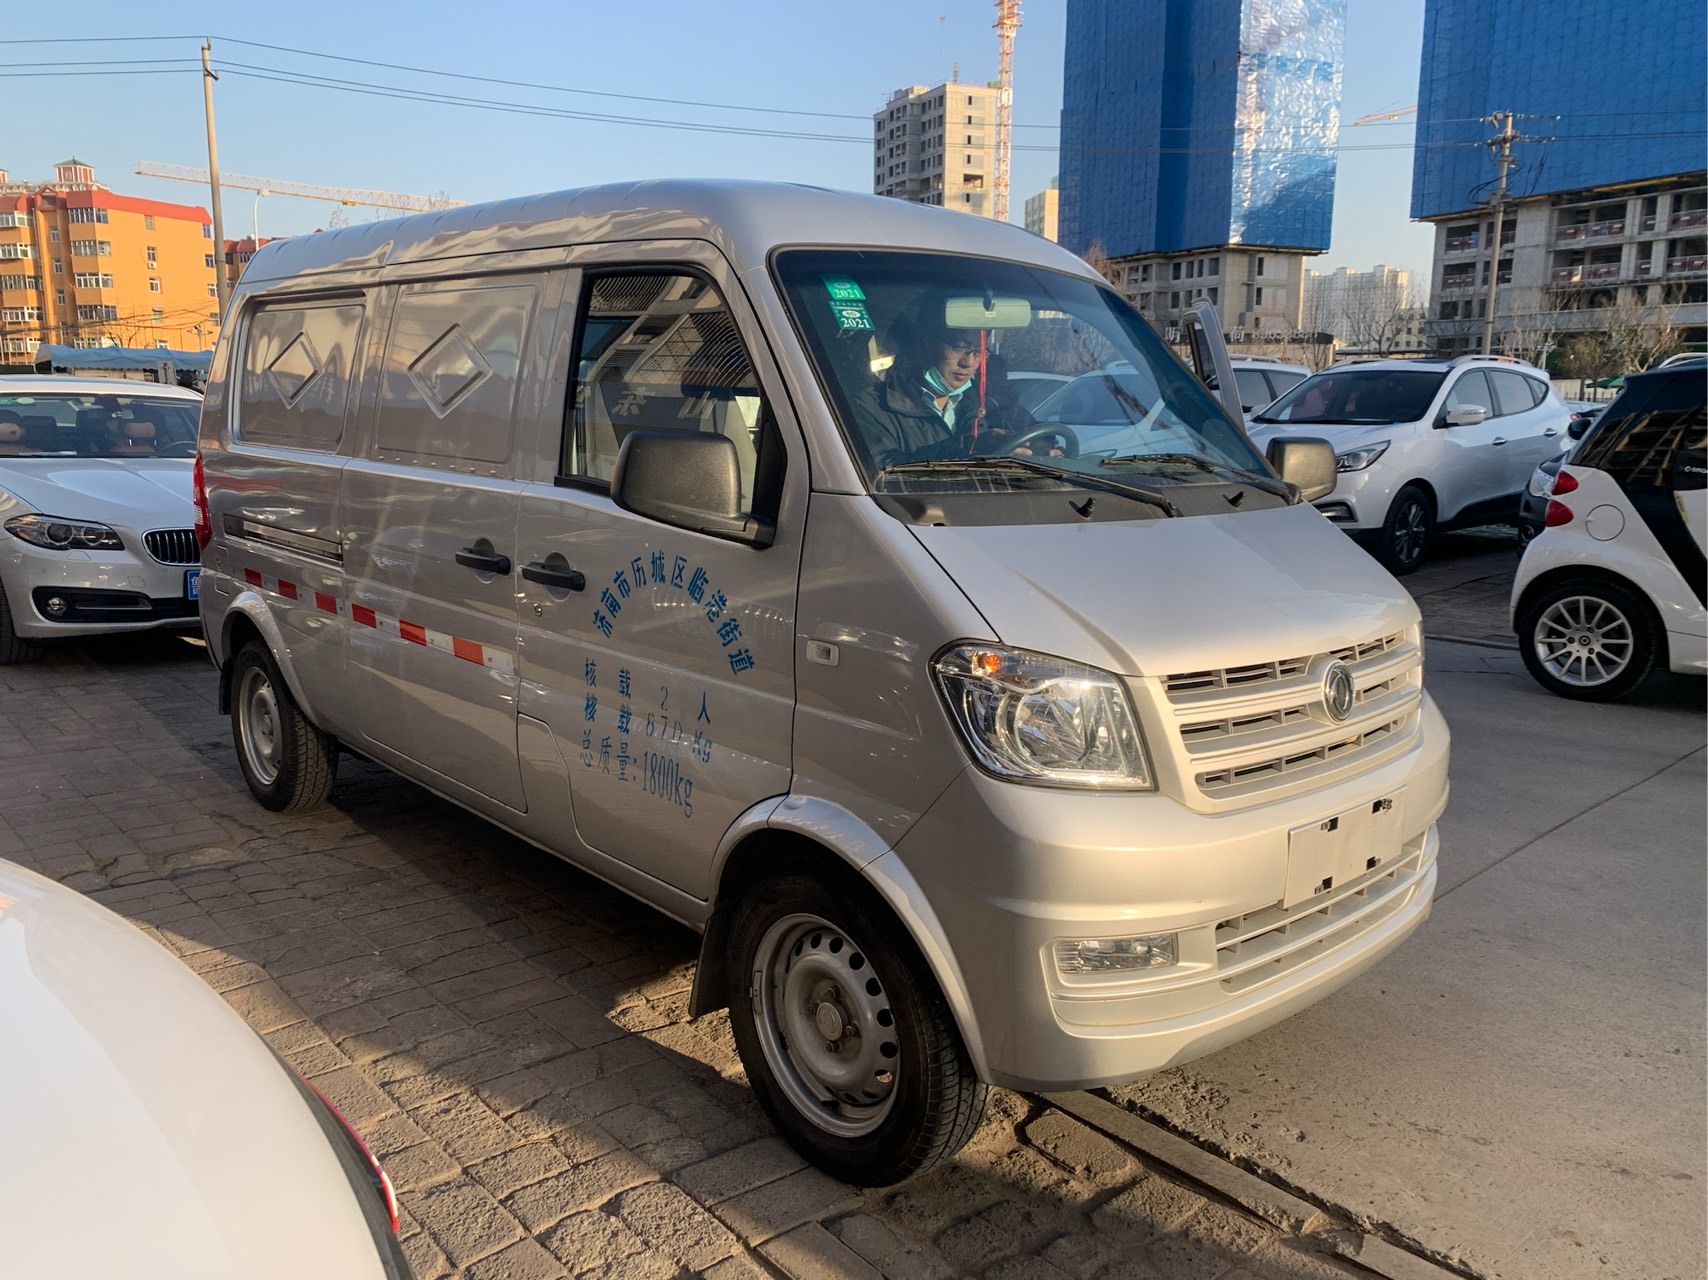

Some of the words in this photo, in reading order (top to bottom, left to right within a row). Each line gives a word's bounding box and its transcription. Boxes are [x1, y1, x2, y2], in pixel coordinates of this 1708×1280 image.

[834, 289, 861, 298] 2021
[841, 317, 871, 329] 2021
[592, 550, 755, 675] 济南市历城区临港街道
